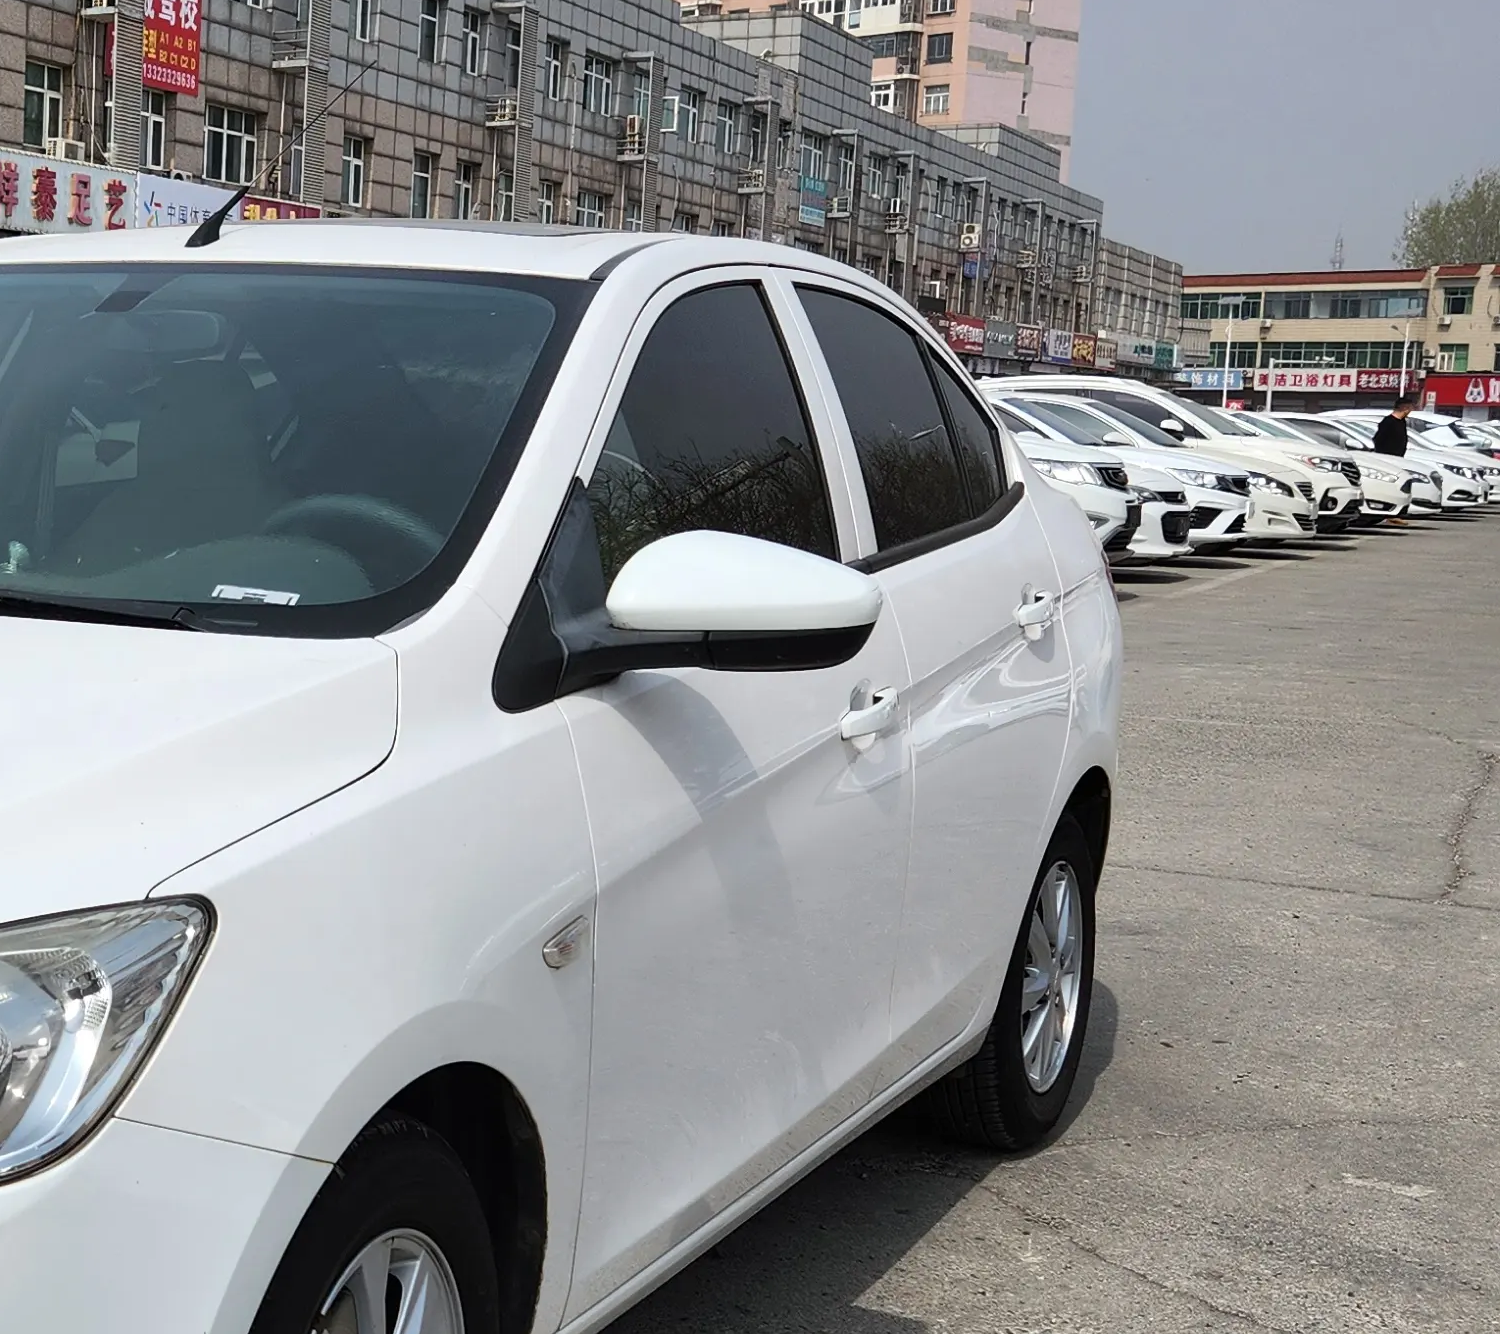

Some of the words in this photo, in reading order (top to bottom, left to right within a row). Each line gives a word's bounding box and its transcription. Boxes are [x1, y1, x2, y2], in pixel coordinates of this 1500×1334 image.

[160, 32, 169, 45] A1
[173, 35, 183, 49] A2
[187, 39, 196, 52] B1
[159, 49, 168, 62] B2
[170, 52, 178, 65] C1
[180, 55, 188, 68] C2
[167, 202, 233, 225] 中国体育
